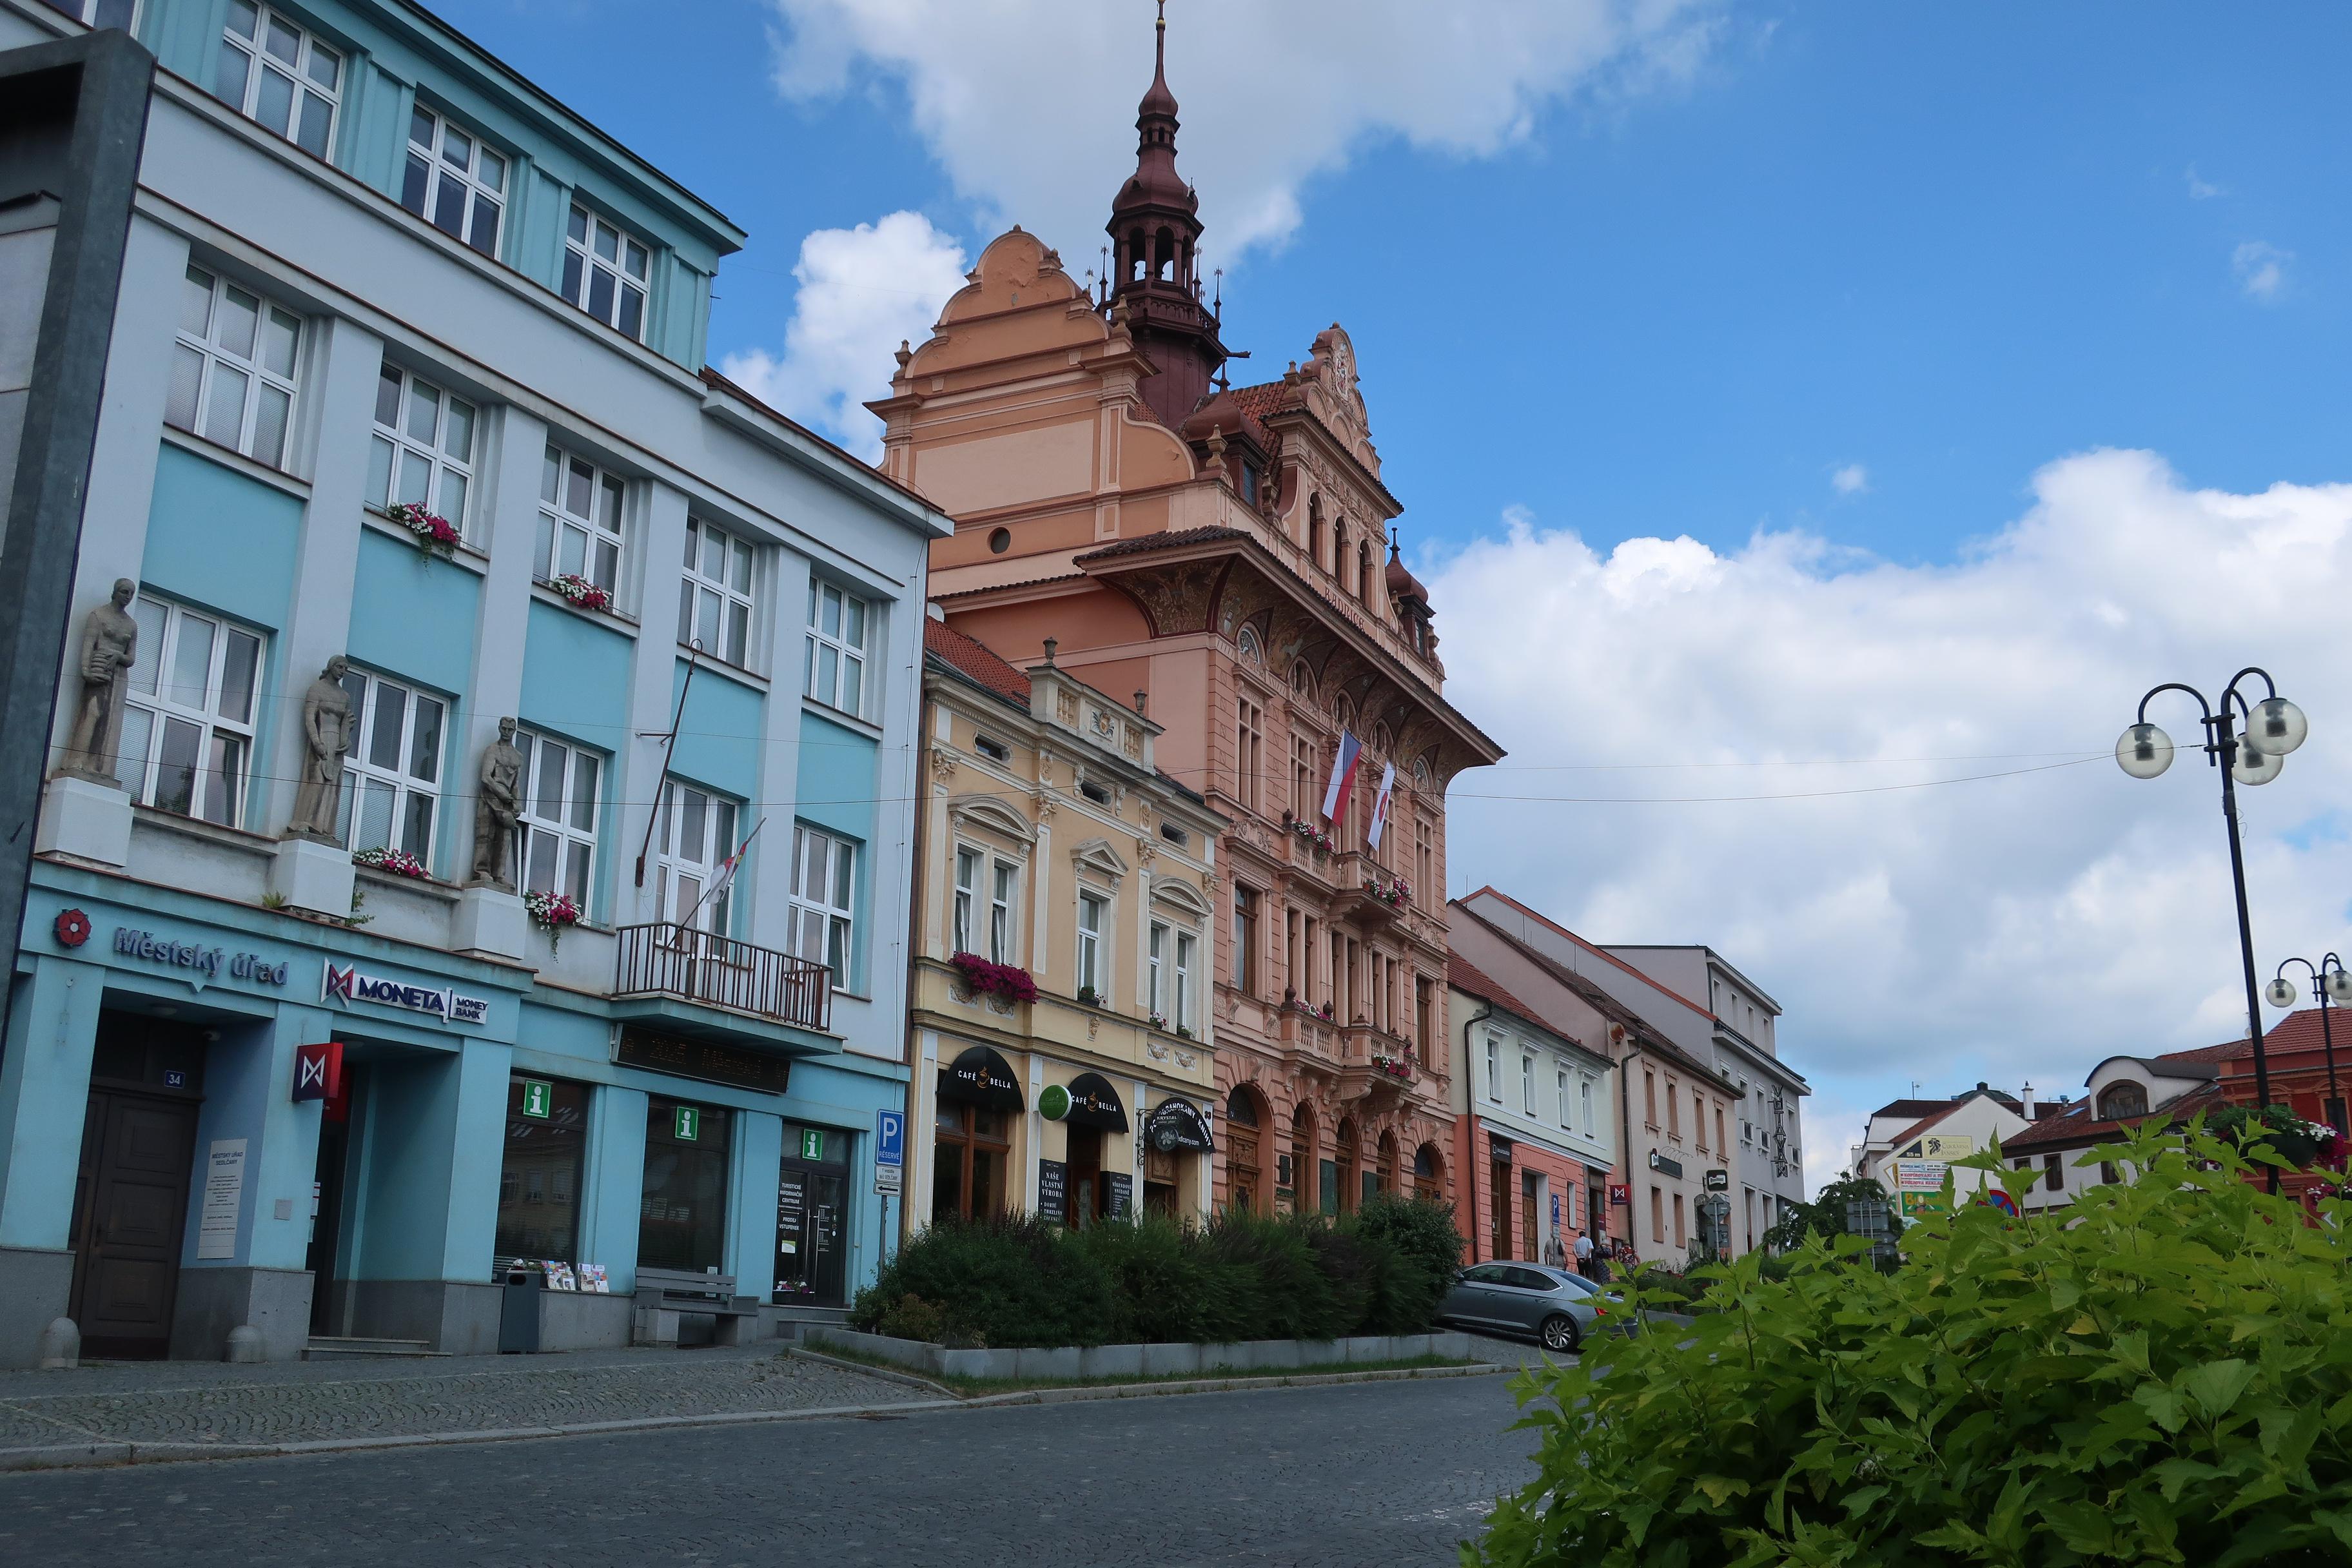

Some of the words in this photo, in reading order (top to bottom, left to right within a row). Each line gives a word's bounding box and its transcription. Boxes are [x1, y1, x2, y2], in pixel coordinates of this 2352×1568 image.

[113, 926, 226, 977] Městský
[231, 952, 289, 985] úřad
[358, 977, 445, 1012] MONETA
[456, 997, 488, 1010] MONEY
[456, 1007, 481, 1019] BANK
[169, 1074, 181, 1084] 34
[958, 1070, 976, 1081] CAFÉ
[990, 1078, 1010, 1089] BELLA
[1072, 1096, 1087, 1105] CAFÉ
[1099, 1102, 1116, 1112] BELLA
[883, 1117, 897, 1147] P
[1197, 1119, 1211, 1146] KNIHY
[879, 1150, 899, 1160] RÉSERVÉ
[1046, 1171, 1059, 1180] NAŠE
[1041, 1180, 1063, 1190] VLASTNÍ
[1042, 1188, 1062, 1199] VÝROBA
